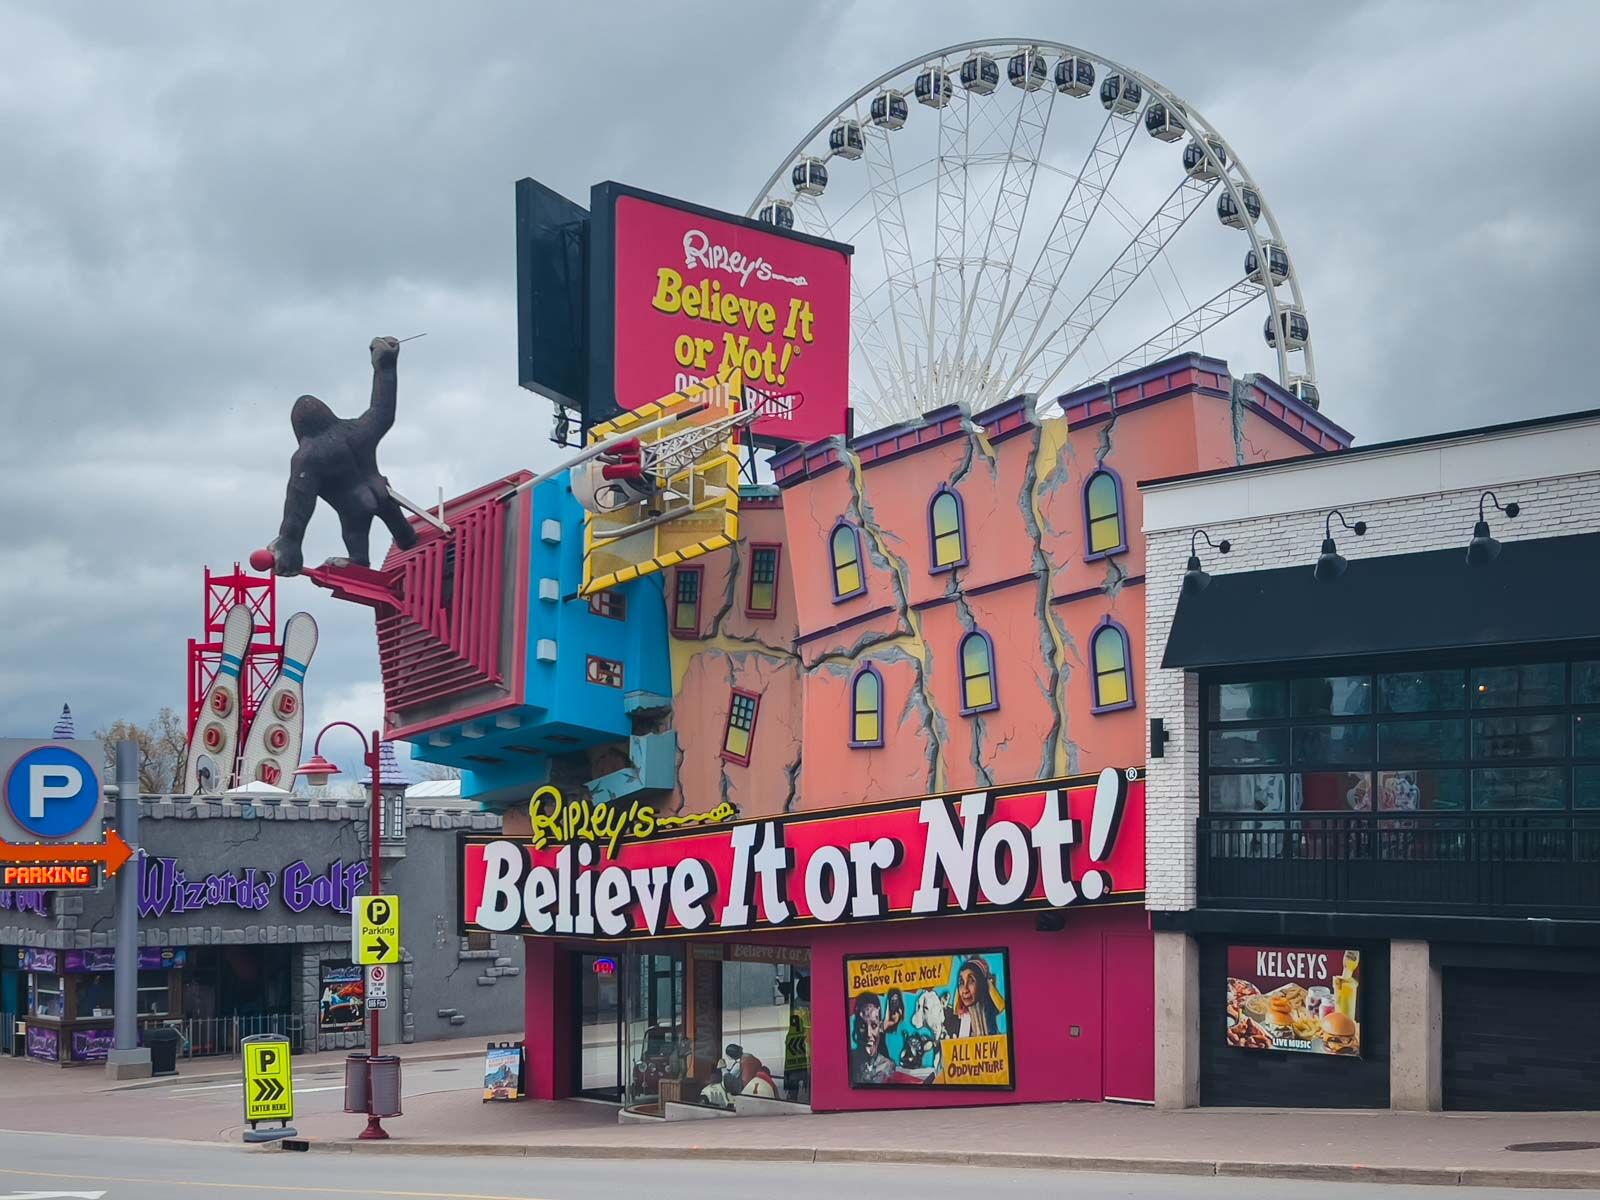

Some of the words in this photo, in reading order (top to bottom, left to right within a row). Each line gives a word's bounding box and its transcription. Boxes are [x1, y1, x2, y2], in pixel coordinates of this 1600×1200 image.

[652, 267, 776, 333] Believe
[783, 298, 814, 342] It
[675, 334, 714, 371] or
[29, 764, 84, 818] P
[475, 840, 709, 935] Believe
[720, 821, 790, 927] It
[805, 837, 895, 922] or
[911, 767, 1119, 911] Not!
[4, 866, 89, 885] PARKING
[283, 859, 369, 914] Golf
[372, 902, 387, 922] P
[362, 926, 395, 938] Parking
[853, 974, 890, 989] Believe
[893, 970, 903, 983] It
[905, 971, 916, 982] or
[919, 963, 942, 980] Not!
[1257, 951, 1328, 980] KELSEYS
[952, 1044, 970, 1061] ALL
[975, 1041, 998, 1060] NEW
[1272, 1038, 1288, 1047] LIVE
[1289, 1039, 1311, 1049] MUSIC
[260, 1050, 276, 1072] P
